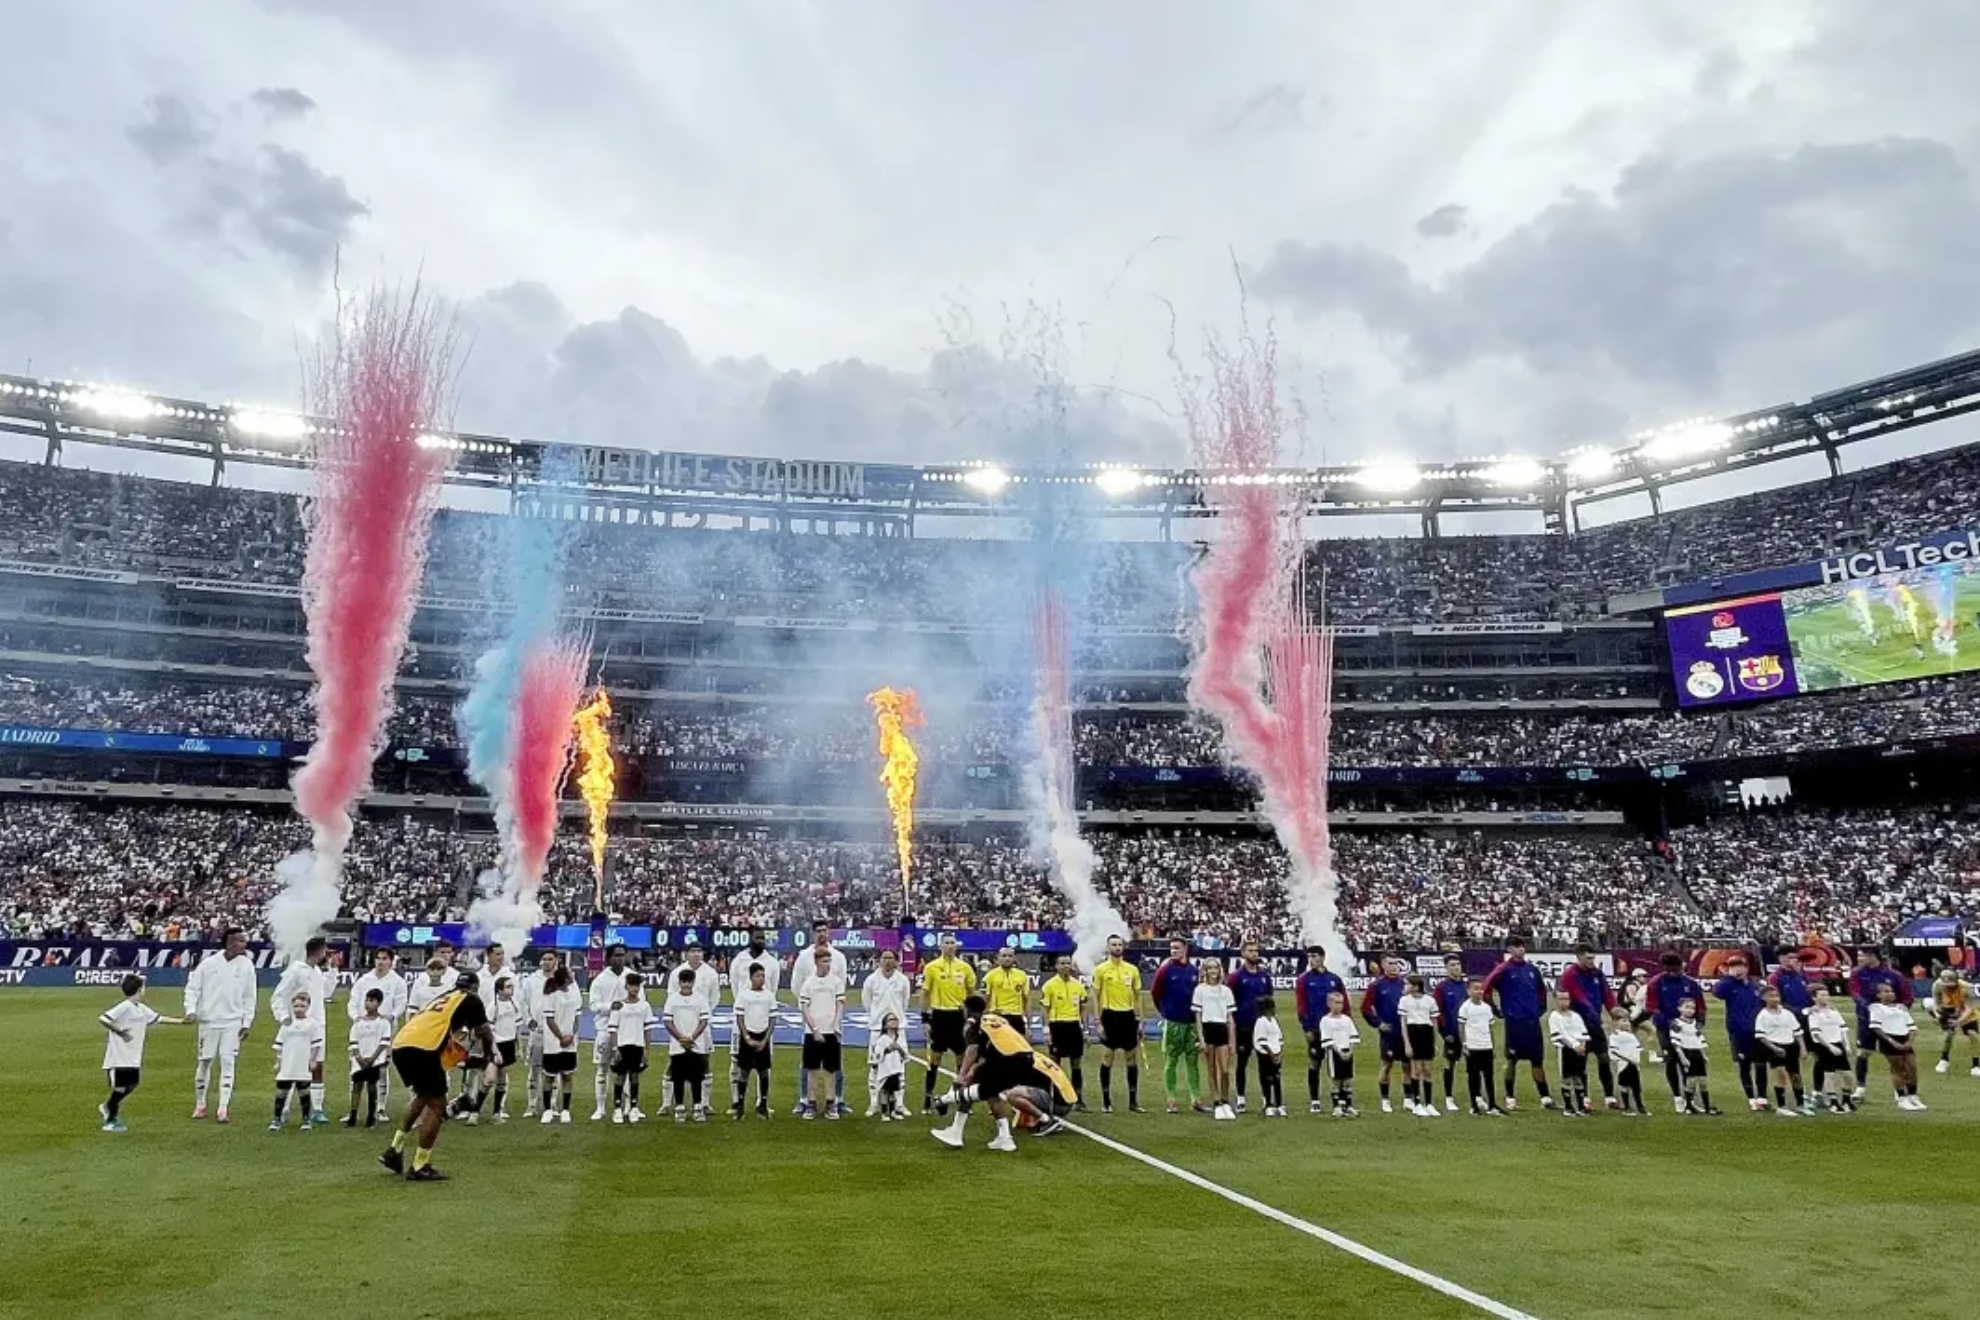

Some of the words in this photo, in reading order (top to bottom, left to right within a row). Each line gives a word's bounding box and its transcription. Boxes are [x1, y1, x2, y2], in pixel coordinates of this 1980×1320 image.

[576, 447, 711, 488] METLIFE
[725, 458, 865, 496] STADIUM
[1820, 530, 1980, 584] HCLTech
[713, 930, 750, 947] 0:00
[794, 930, 805, 947] 0
